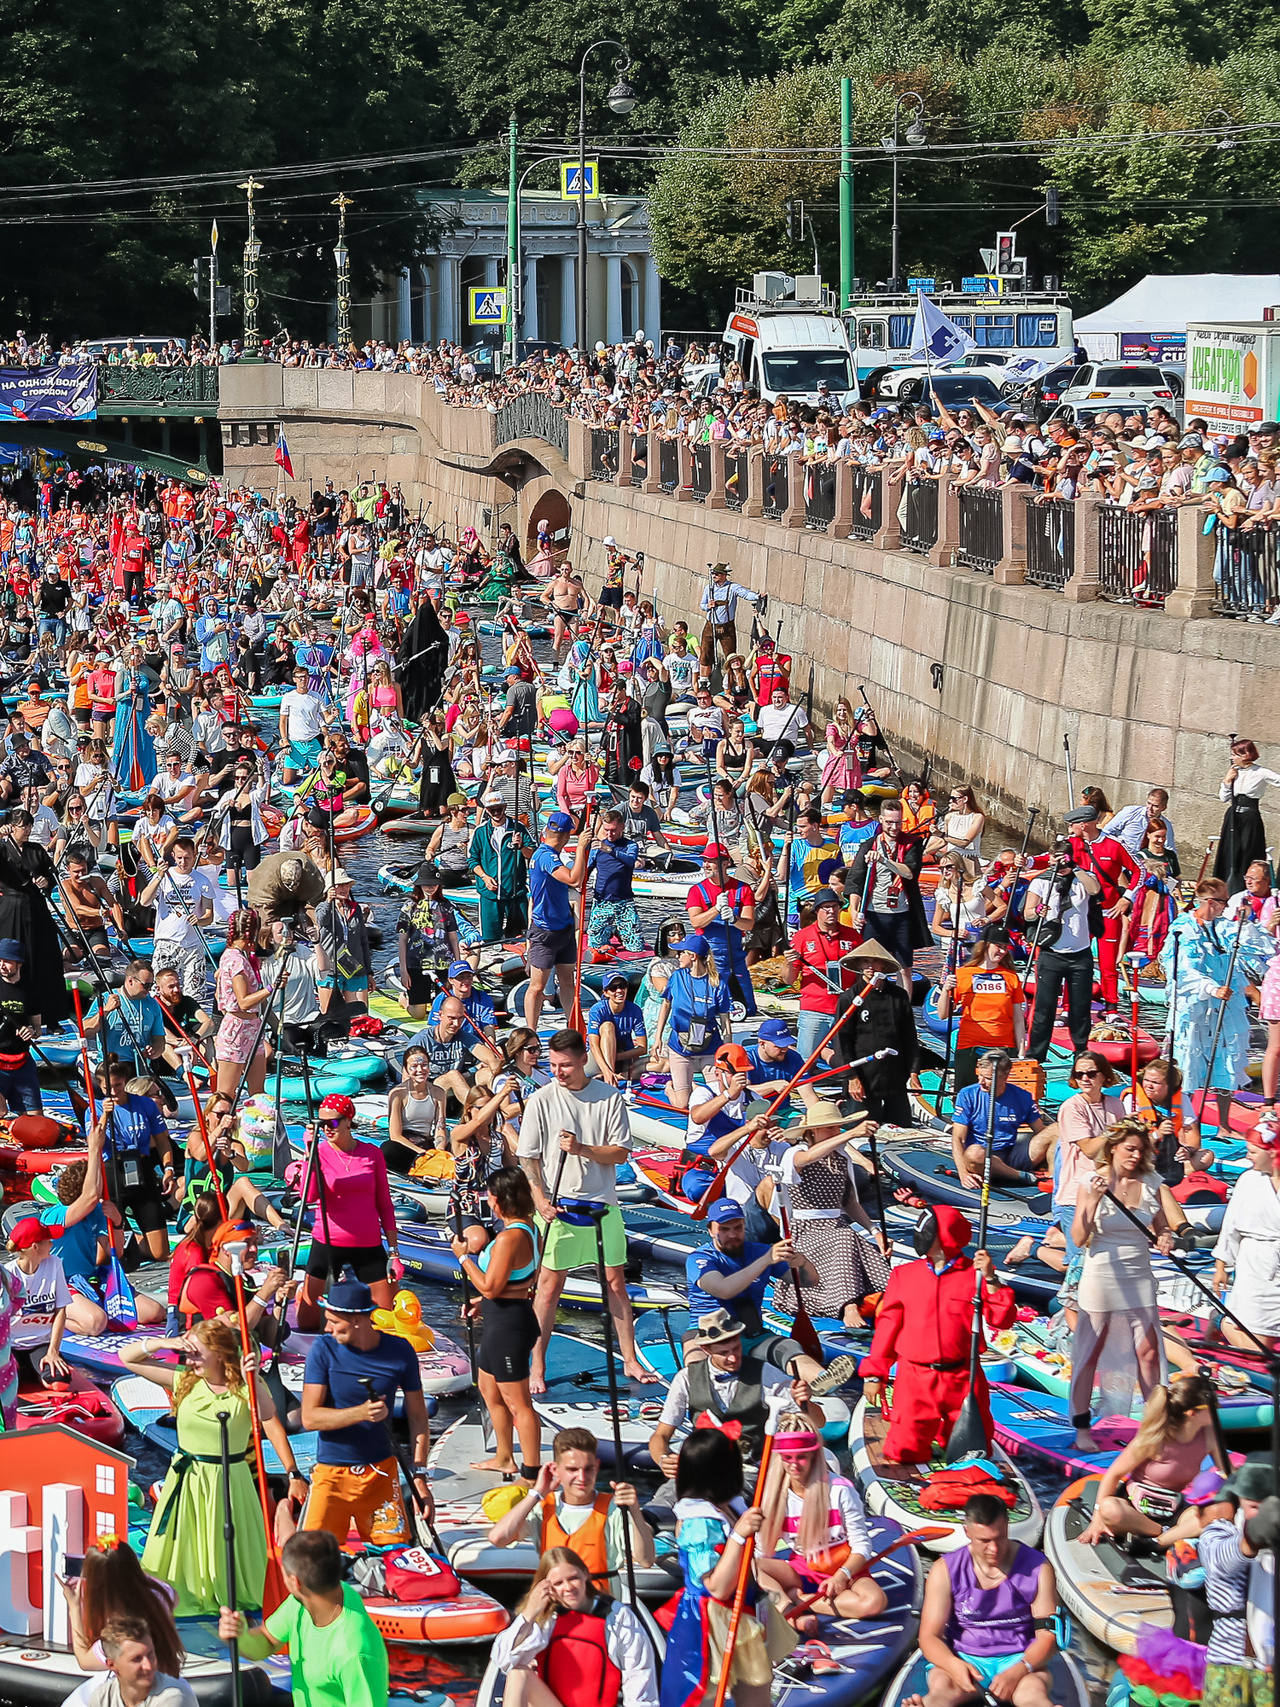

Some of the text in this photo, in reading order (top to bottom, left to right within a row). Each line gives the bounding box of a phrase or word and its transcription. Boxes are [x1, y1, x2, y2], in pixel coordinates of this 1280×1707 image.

[1192, 346, 1240, 395] КУБАТУРА
[1, 376, 89, 391] НА ОДНОЙ ВОЛНЕ
[29, 388, 68, 397] ГОРОДОМ
[976, 983, 1002, 991] 0186
